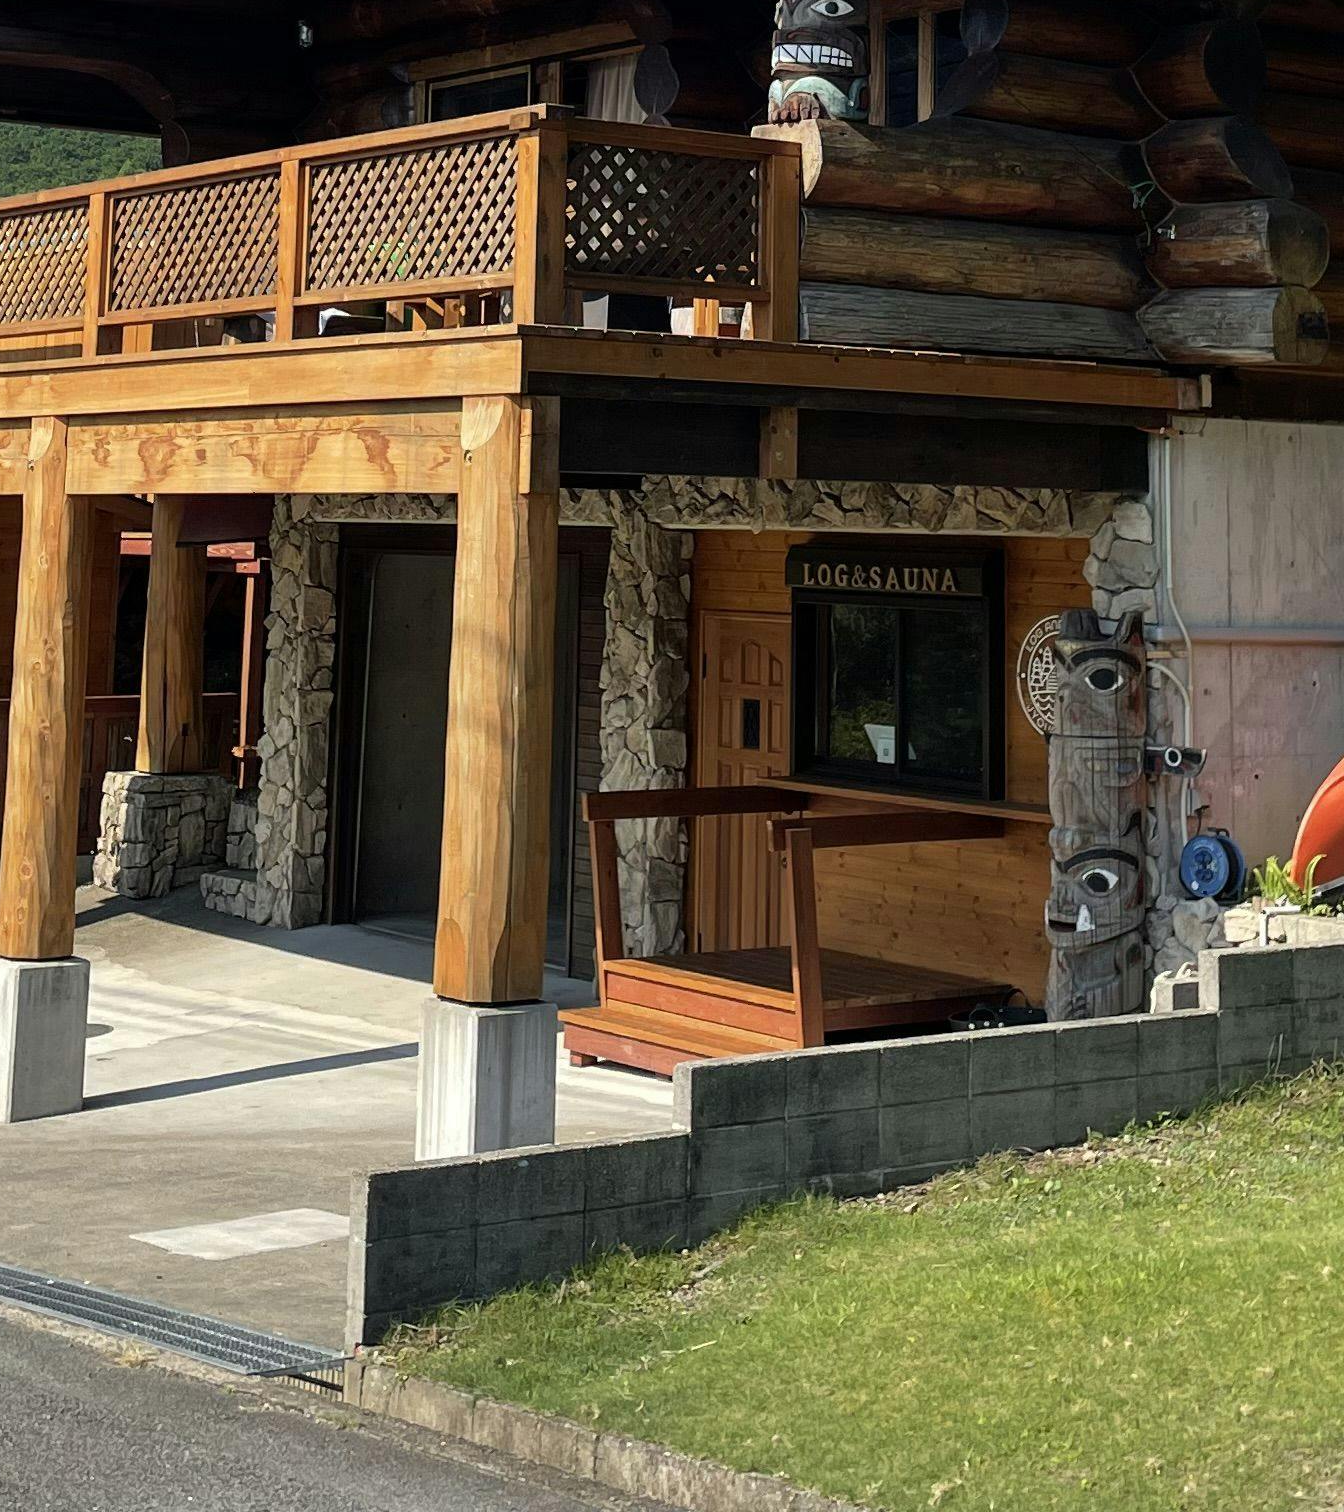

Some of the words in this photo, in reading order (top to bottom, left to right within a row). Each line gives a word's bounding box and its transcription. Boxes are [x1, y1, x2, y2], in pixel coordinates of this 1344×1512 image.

[802, 563, 959, 593] LOG&SAUNA
[1025, 628, 1044, 653] LOG
[1044, 619, 1061, 633] AN
